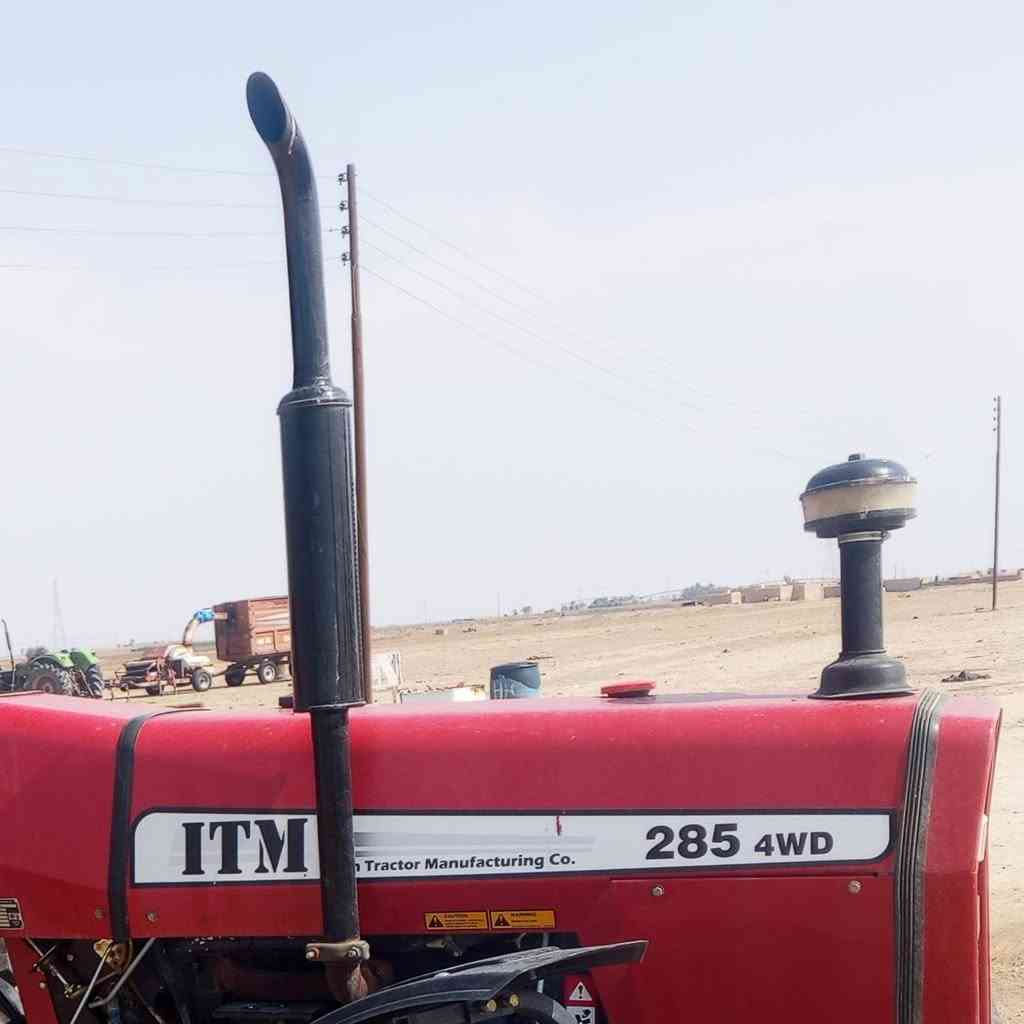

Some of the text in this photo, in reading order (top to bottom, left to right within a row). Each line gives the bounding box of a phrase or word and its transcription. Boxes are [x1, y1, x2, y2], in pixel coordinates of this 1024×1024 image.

[181, 817, 309, 876] ITM
[645, 823, 834, 860] 285 4WD
[364, 859, 422, 872] Tractor
[425, 854, 545, 870] Manufacturing
[549, 853, 576, 866] Co.
